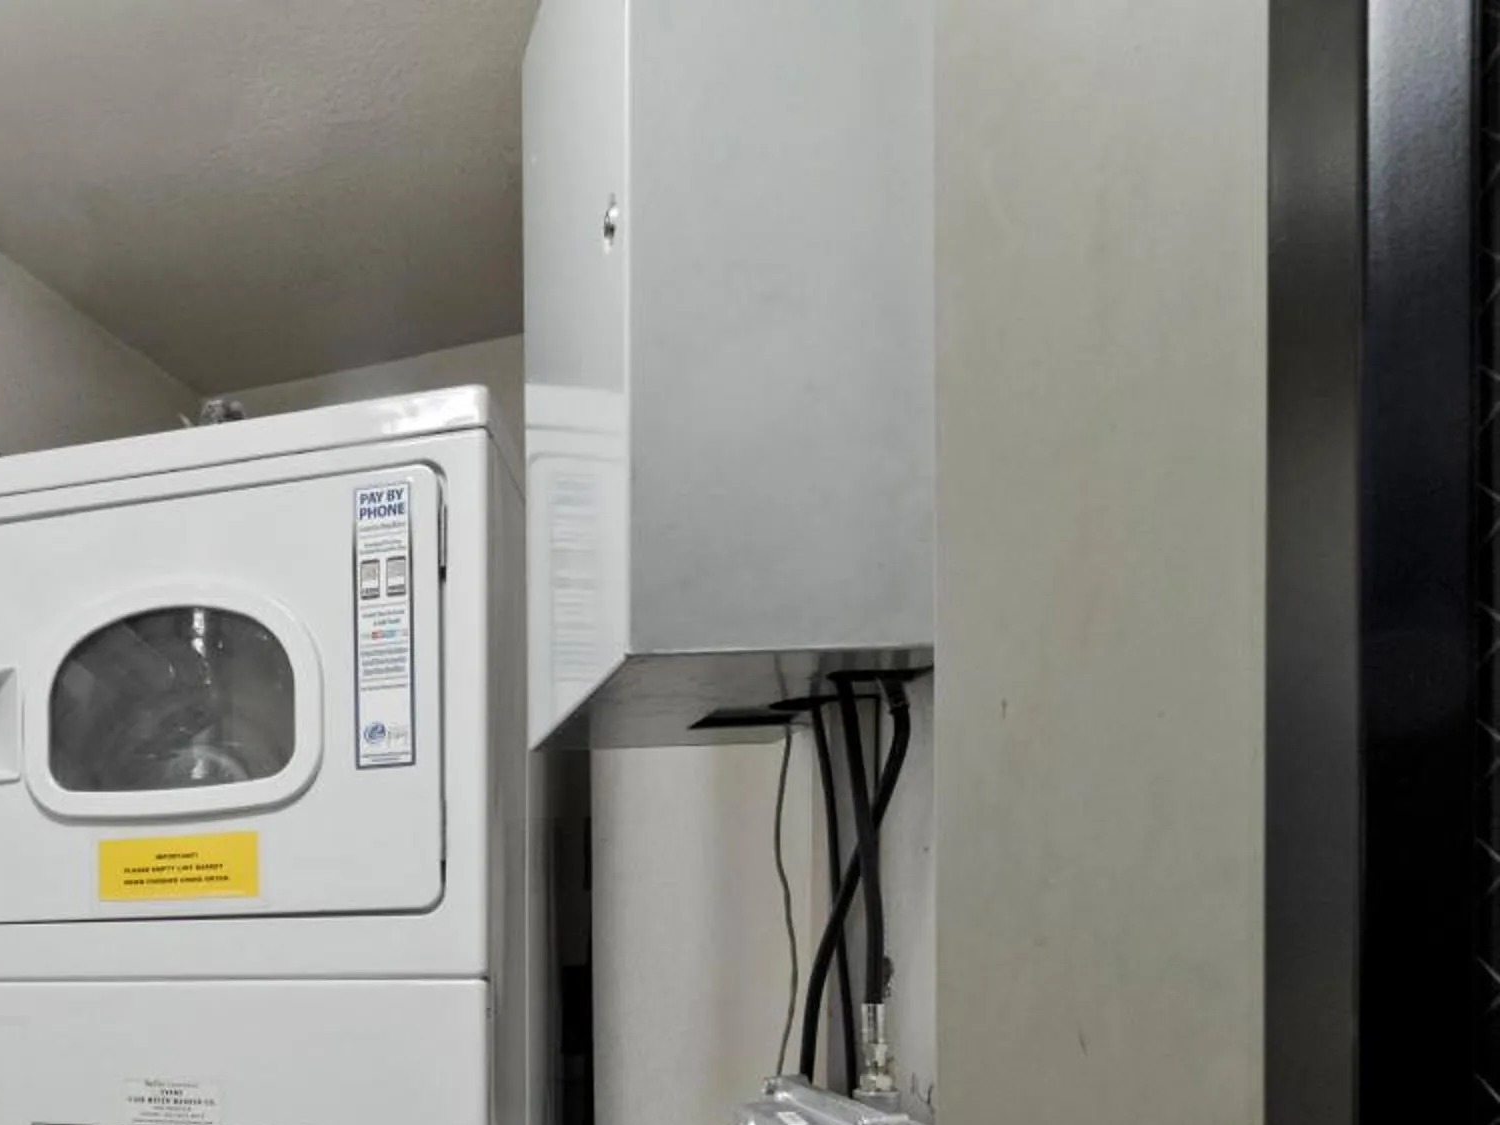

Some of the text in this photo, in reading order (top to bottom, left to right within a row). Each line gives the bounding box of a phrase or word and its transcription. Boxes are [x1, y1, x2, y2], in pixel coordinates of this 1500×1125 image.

[360, 488, 404, 505] PAY BY
[359, 503, 405, 520] PHONE
